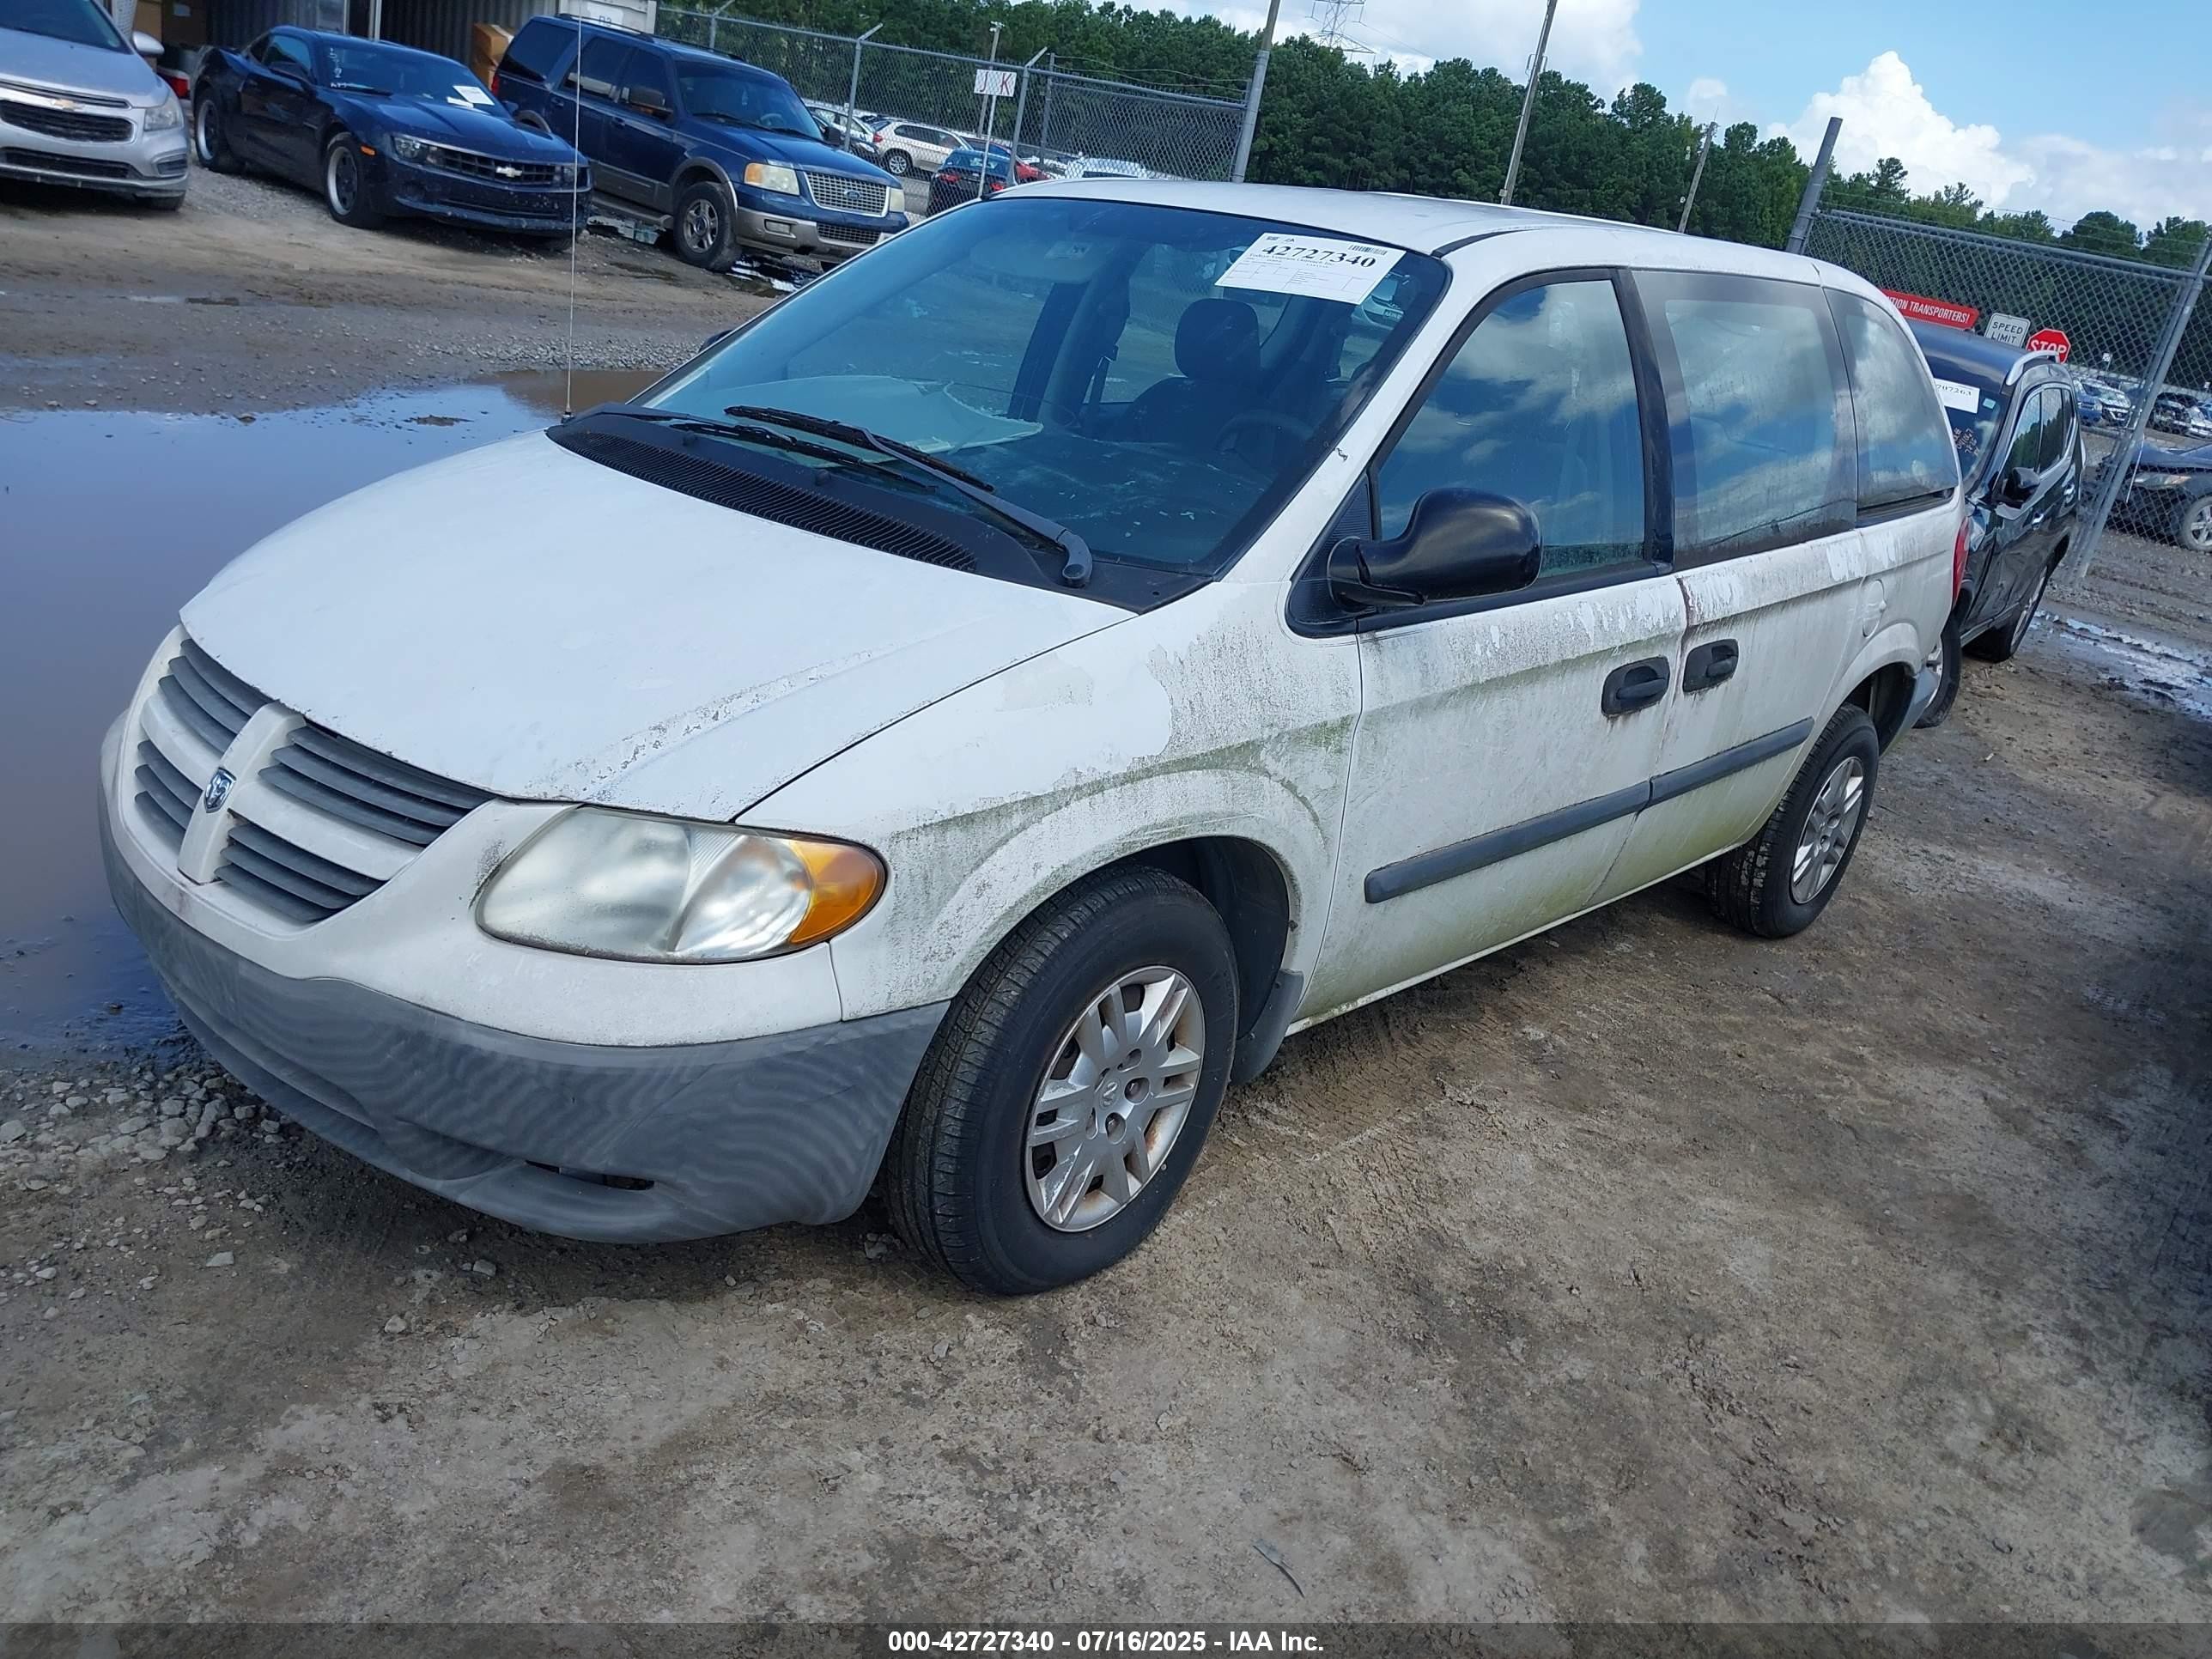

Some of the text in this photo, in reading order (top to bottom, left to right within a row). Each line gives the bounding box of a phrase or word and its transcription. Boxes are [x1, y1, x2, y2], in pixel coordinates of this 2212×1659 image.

[1000, 73, 1012, 94] K
[1261, 244, 1376, 268] 42727340
[1909, 301, 1970, 324] TRANSPORTERS!
[1990, 331, 2017, 343] LIMIT
[1991, 321, 2024, 335] SPEED
